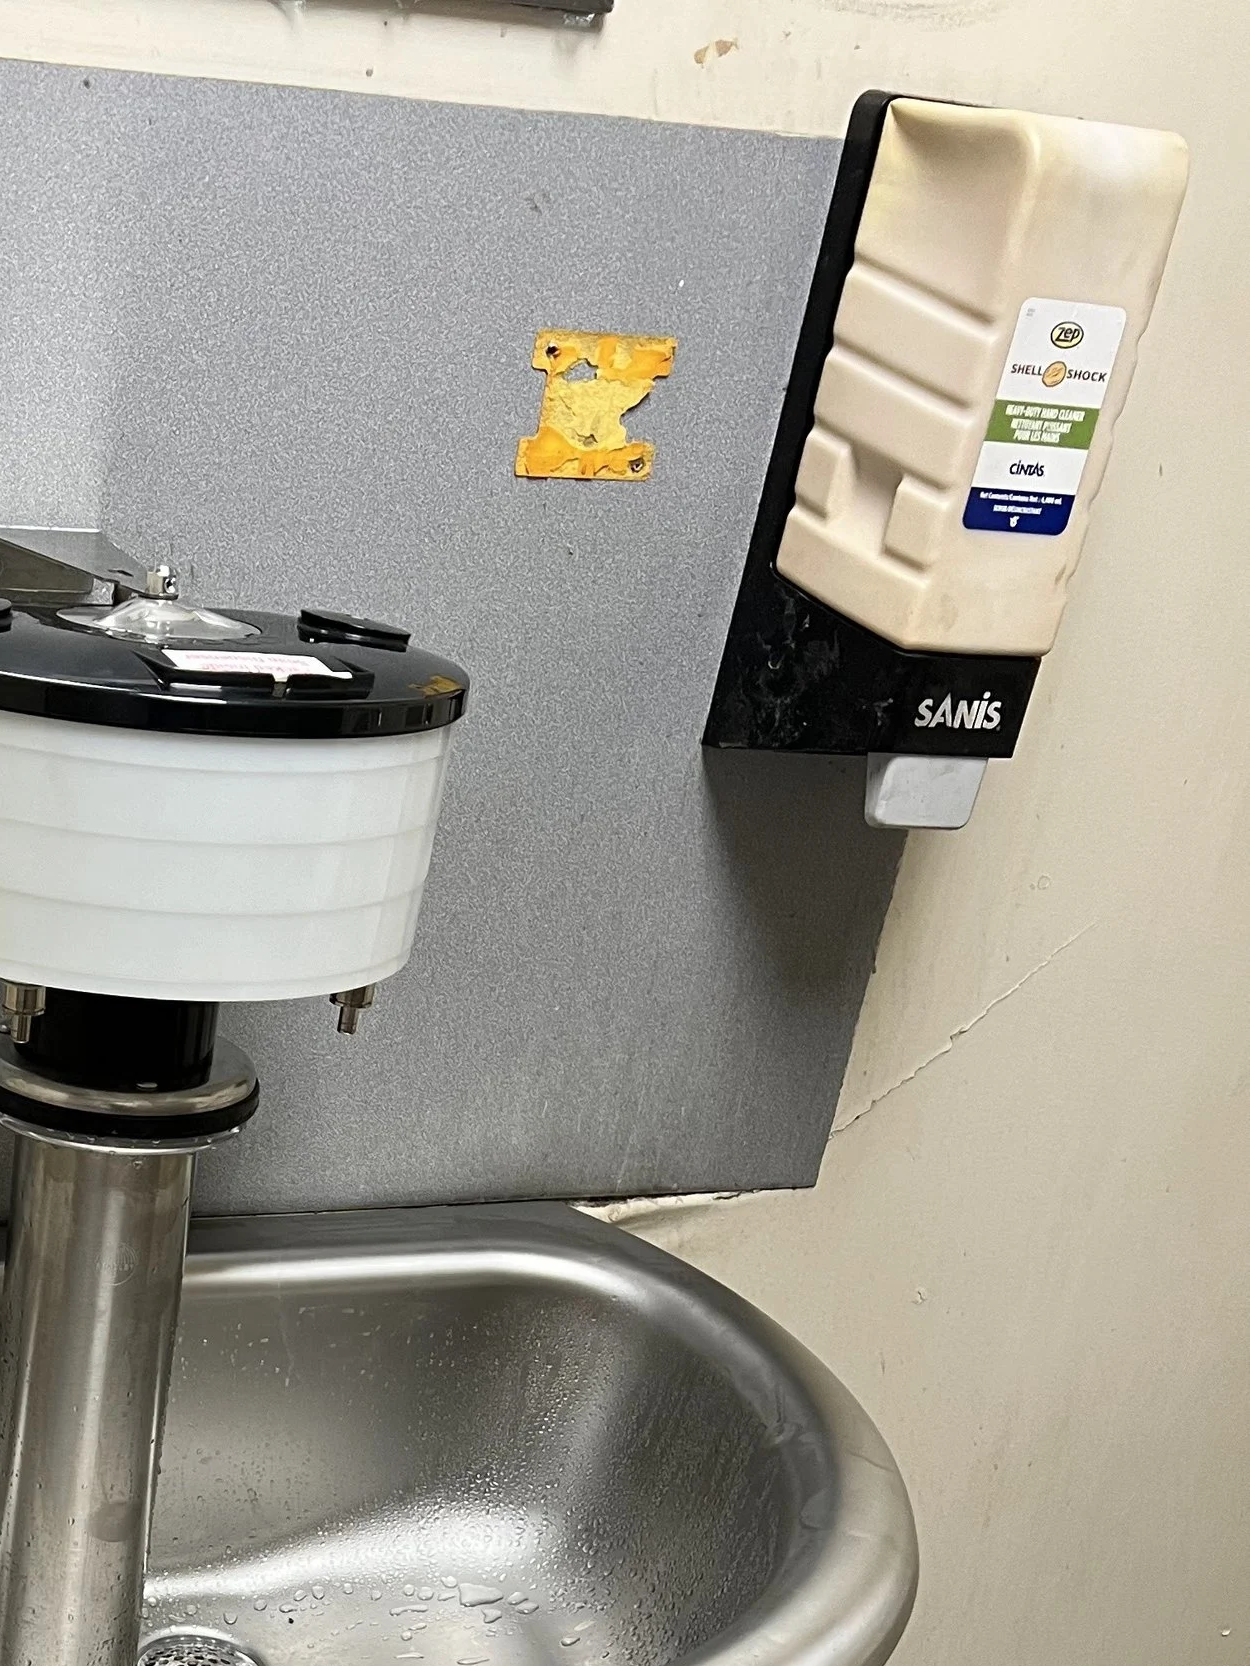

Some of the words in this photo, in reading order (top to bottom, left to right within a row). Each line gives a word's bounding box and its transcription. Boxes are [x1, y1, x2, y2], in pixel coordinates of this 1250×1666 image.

[1011, 363, 1042, 376] SHELL
[1066, 369, 1107, 382] SHOCK
[1040, 407, 1059, 419] HAND
